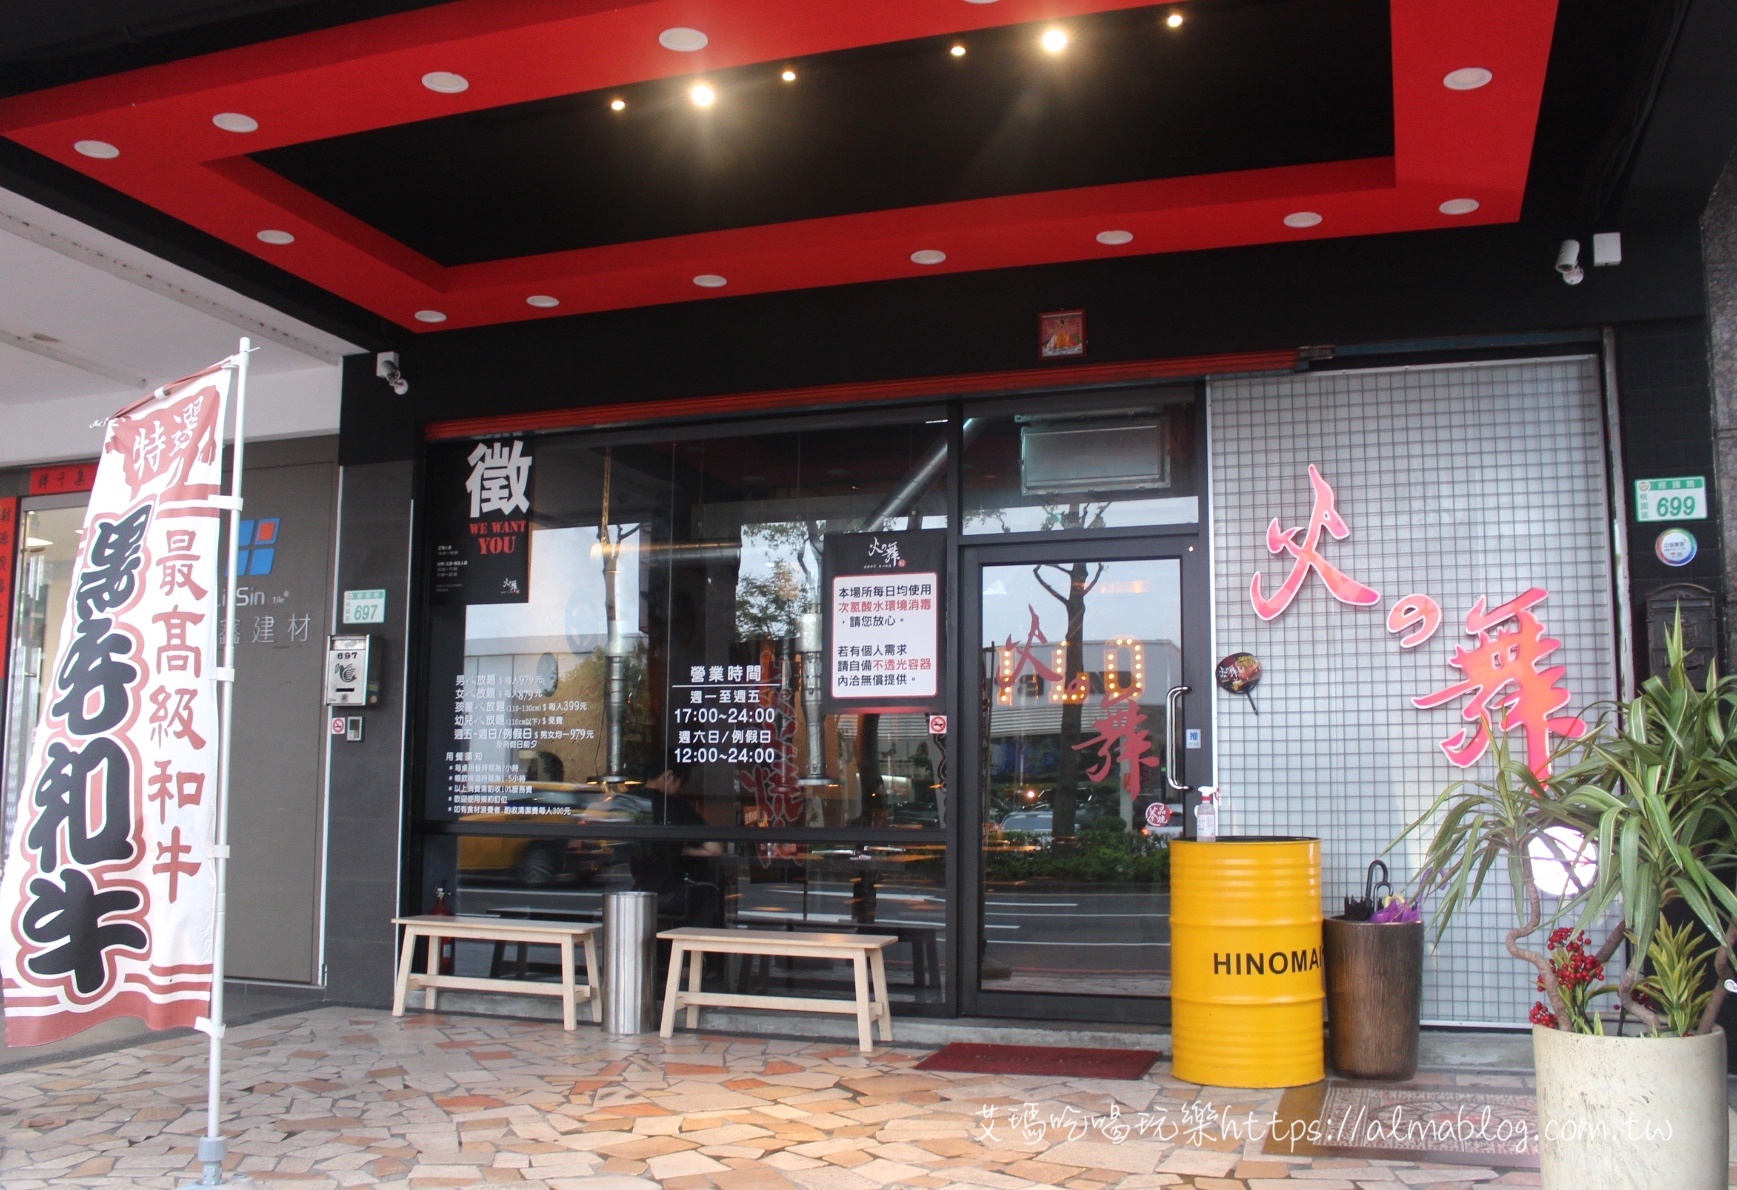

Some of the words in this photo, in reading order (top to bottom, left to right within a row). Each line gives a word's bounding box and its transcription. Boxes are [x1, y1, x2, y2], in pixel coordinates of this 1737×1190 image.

[465, 439, 533, 518] 徵
[1656, 495, 1696, 517] 699
[469, 522, 488, 535] WE
[492, 520, 527, 533] WANT
[478, 535, 516, 555] YOU
[354, 604, 378, 621] 697
[1250, 463, 1588, 793] 火の舞
[337, 652, 358, 660] 697
[837, 644, 908, 658] 若有個人需求
[837, 658, 932, 672] 請自備不透光容器
[690, 665, 763, 682] 營業時間
[690, 690, 761, 704] 週一至週五
[674, 708, 775, 723] 17:00~24:00
[678, 730, 771, 744] 週六日/例假日
[674, 748, 775, 763] 12:00~24:00
